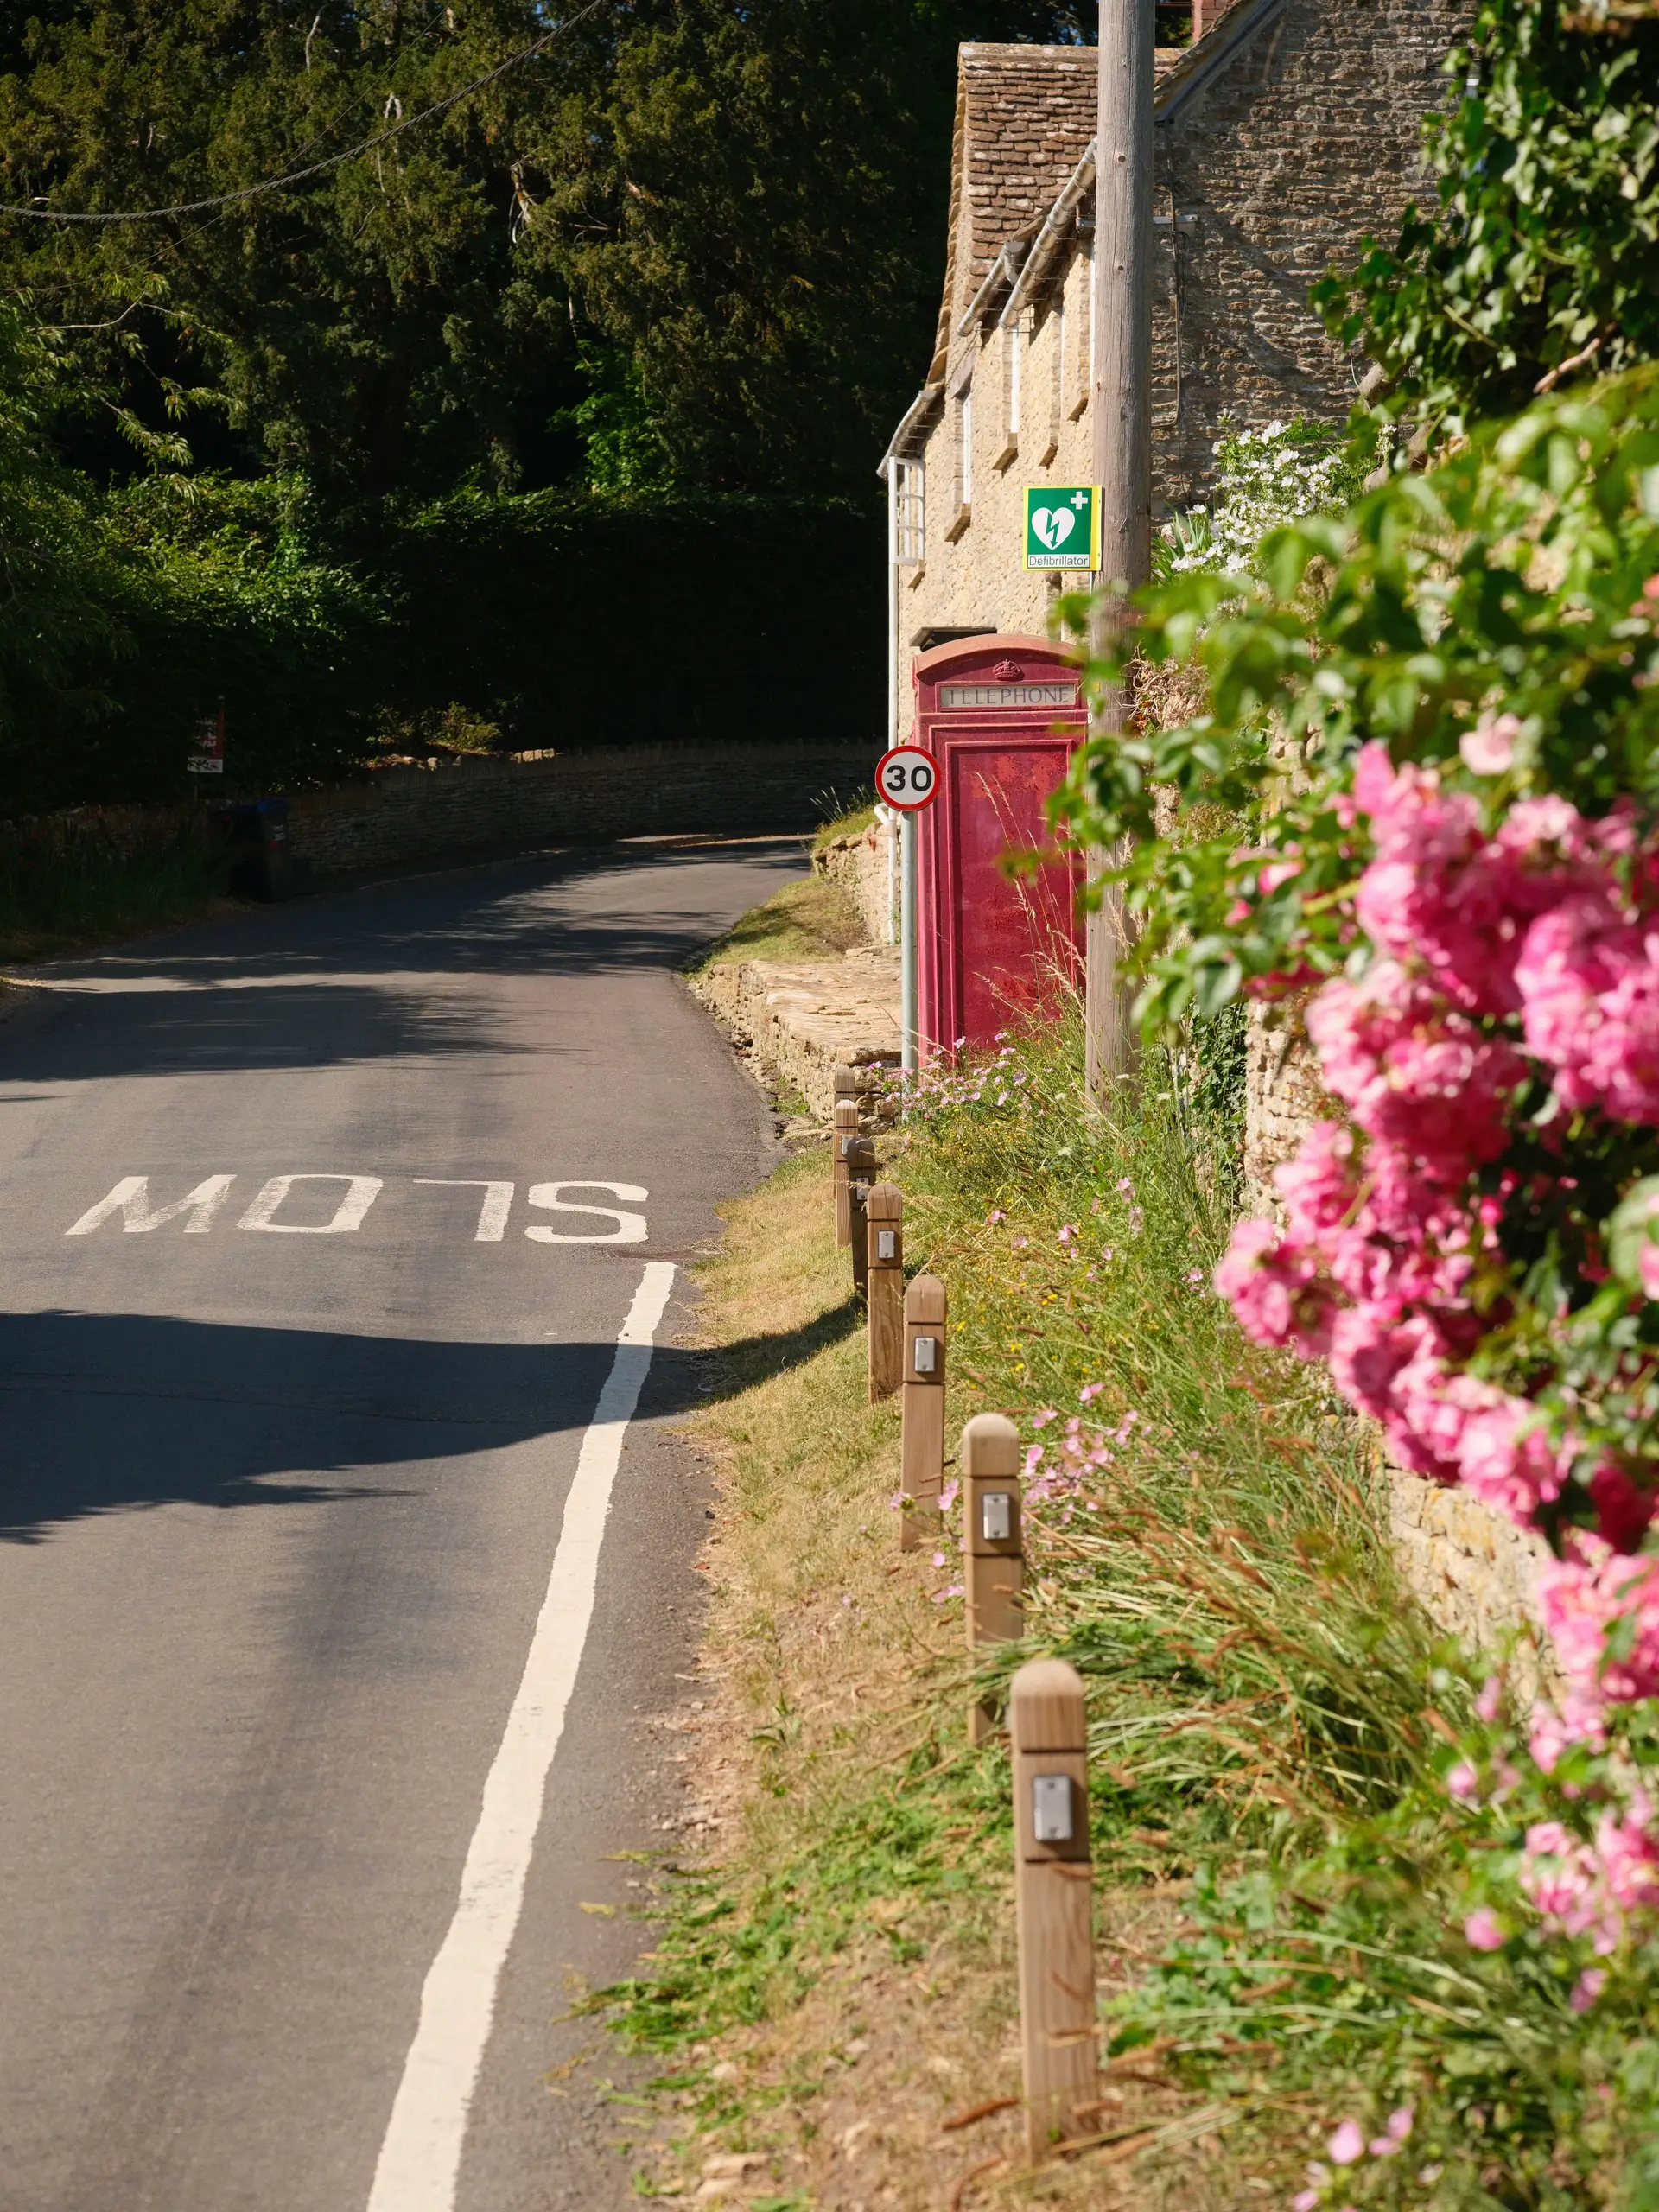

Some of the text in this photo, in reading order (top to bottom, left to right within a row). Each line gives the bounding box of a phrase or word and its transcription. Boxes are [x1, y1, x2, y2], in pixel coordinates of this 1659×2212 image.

[1029, 556, 1088, 566] Defibrillator
[946, 686, 1069, 705] TELEPHONE
[887, 765, 932, 792] 30
[64, 1173, 650, 1245] SLOW
